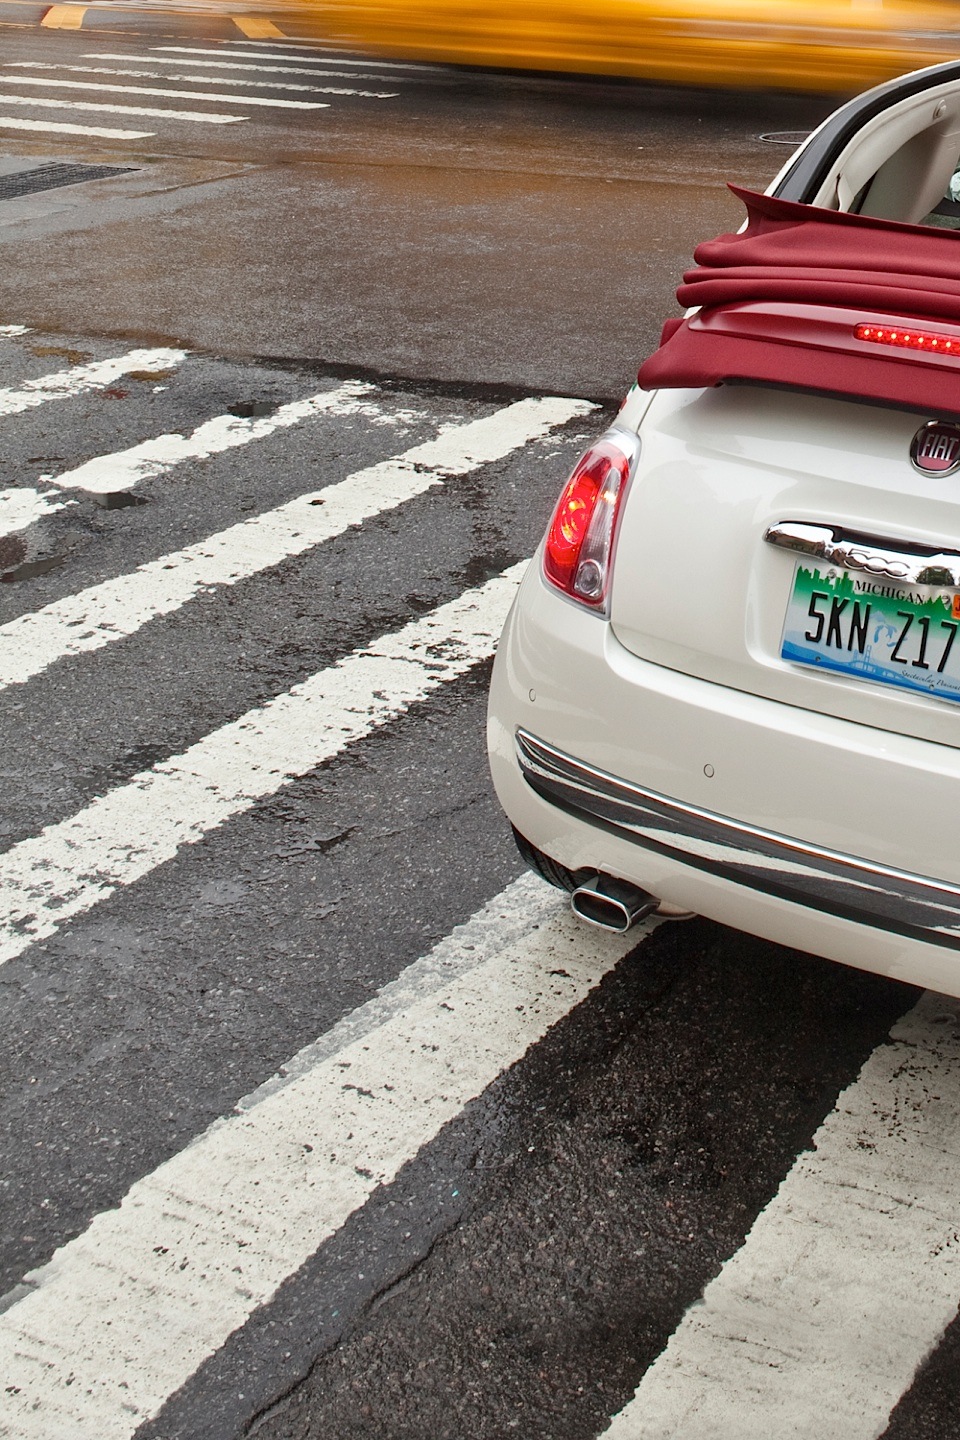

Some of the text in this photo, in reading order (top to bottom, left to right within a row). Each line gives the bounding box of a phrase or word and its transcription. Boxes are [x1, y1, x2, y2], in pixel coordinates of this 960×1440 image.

[921, 433, 959, 461] FIAT
[844, 548, 911, 579] 500
[855, 580, 925, 604] MICHIGAN
[804, 591, 958, 673] 5KN Z17
